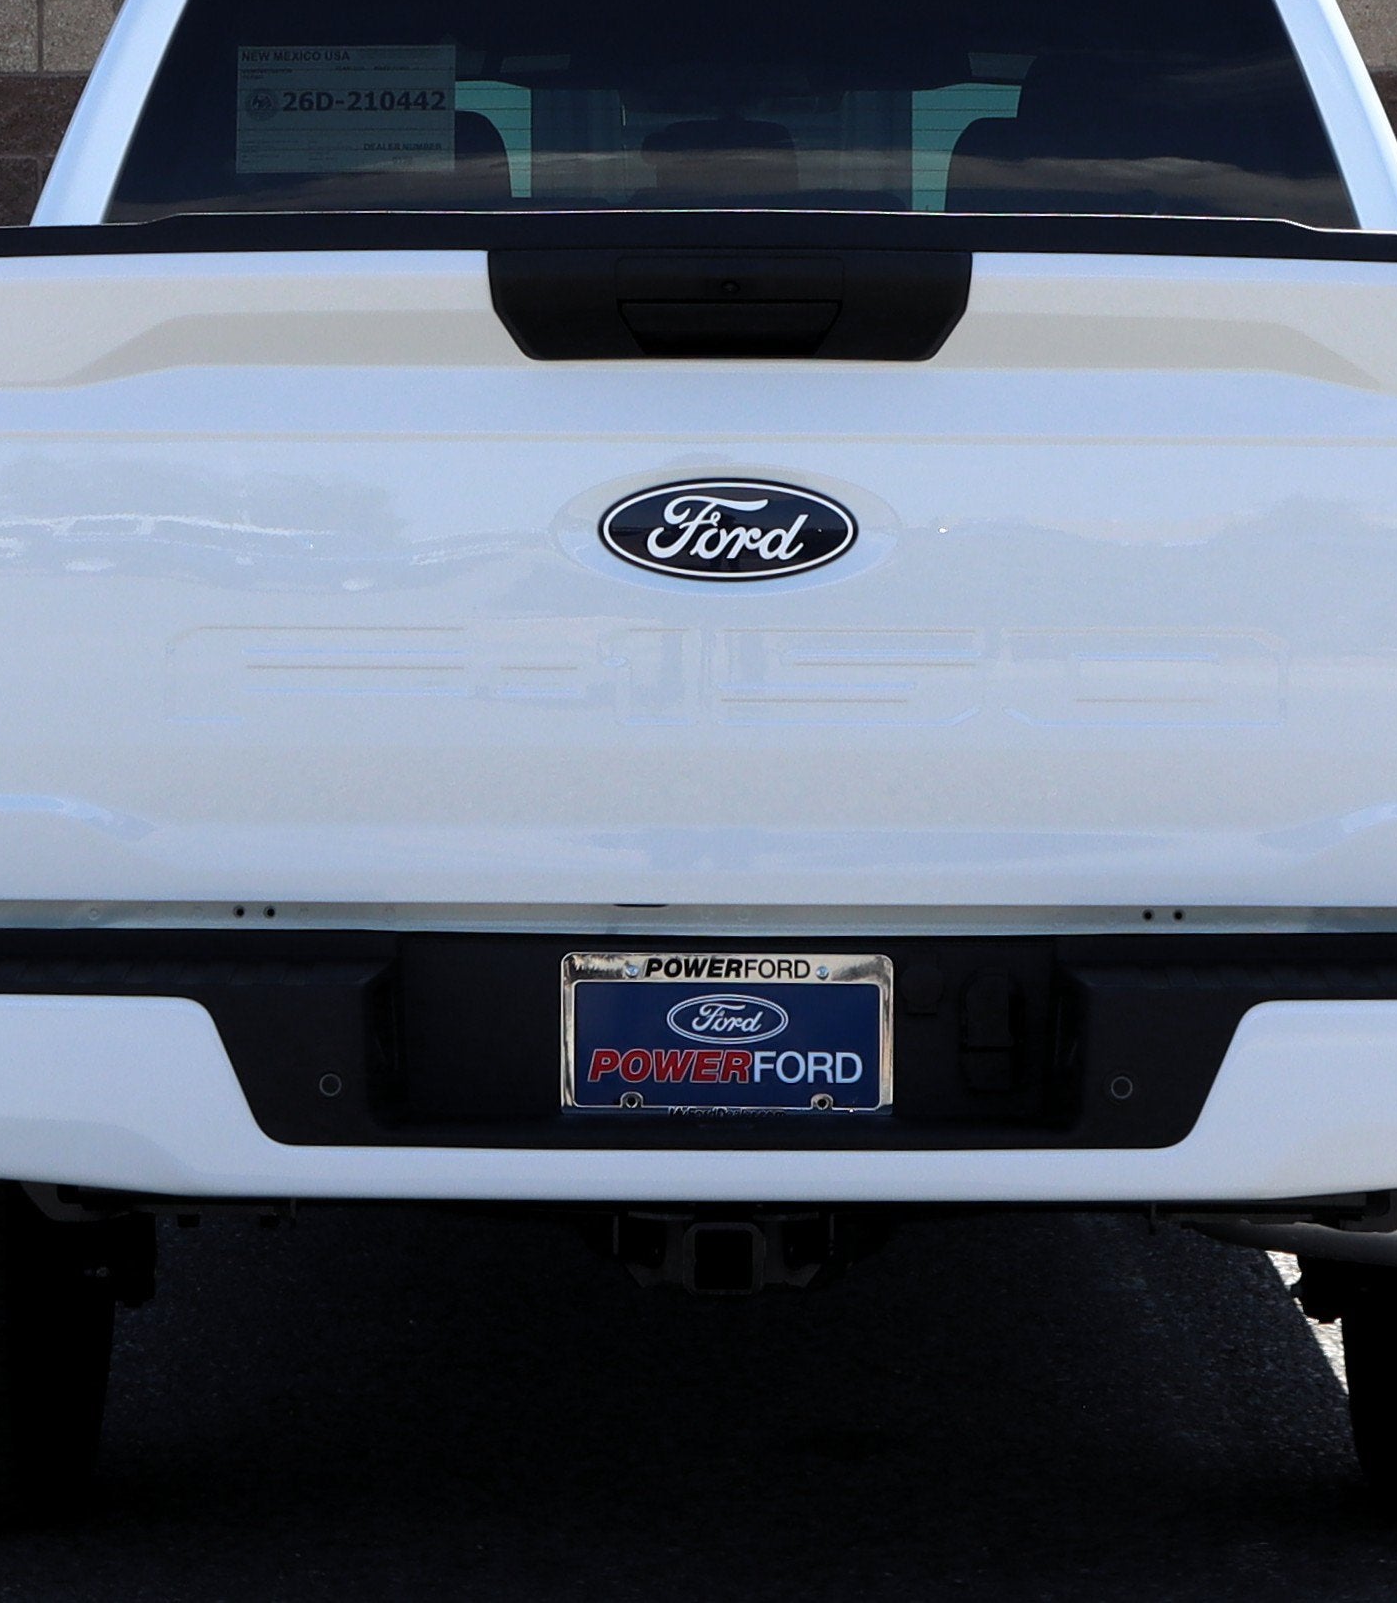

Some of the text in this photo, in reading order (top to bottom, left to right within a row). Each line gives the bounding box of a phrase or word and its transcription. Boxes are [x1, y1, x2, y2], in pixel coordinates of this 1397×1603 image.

[241, 51, 351, 62] NEW MEXICO USA
[282, 90, 446, 111] 26D-210442
[363, 142, 401, 151] DEALER
[402, 142, 443, 151] NUMBER
[646, 495, 809, 561] Ford
[643, 957, 811, 980] POWERFORD
[691, 1002, 764, 1034] Ford
[587, 1048, 864, 1085] POWERFORD
